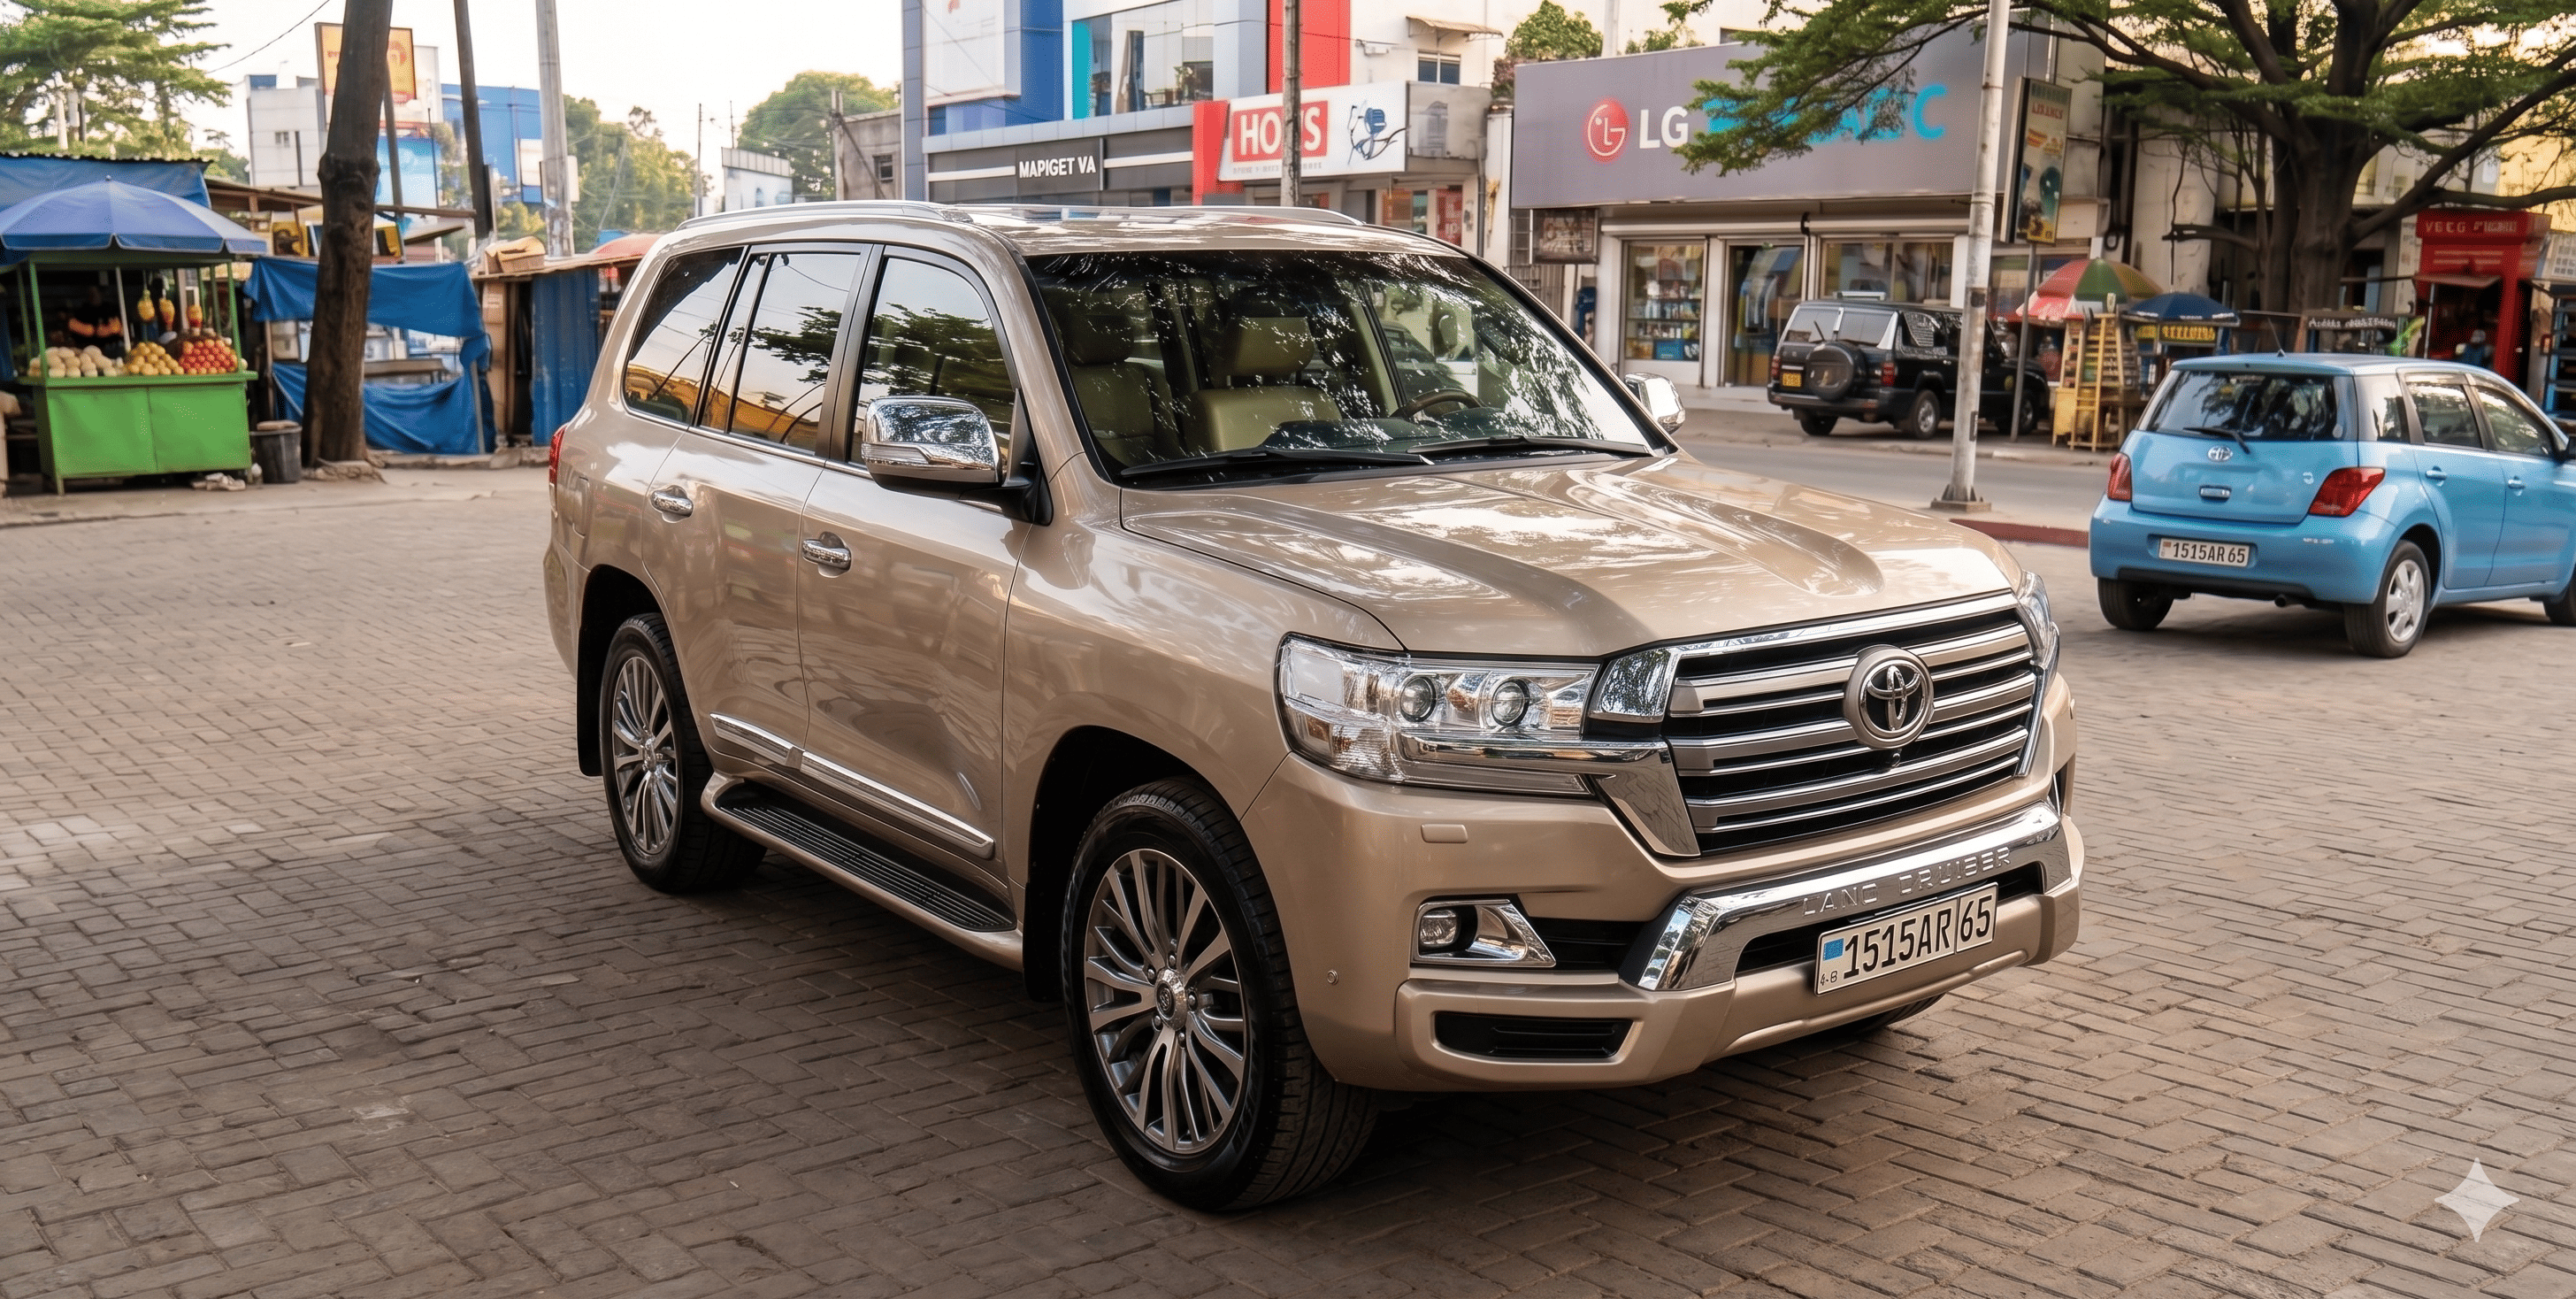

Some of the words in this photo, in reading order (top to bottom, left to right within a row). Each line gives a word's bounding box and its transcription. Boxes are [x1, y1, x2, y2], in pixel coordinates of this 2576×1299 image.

[1240, 106, 1322, 156] HOS
[1638, 105, 1689, 149] LG
[1019, 157, 1075, 179] MAPIGET
[1077, 155, 1096, 174] VA
[2173, 542, 2225, 562] 1515AR
[2227, 548, 2246, 564] 65
[1843, 908, 1952, 980] 1515AR
[1960, 895, 1993, 942] 65
